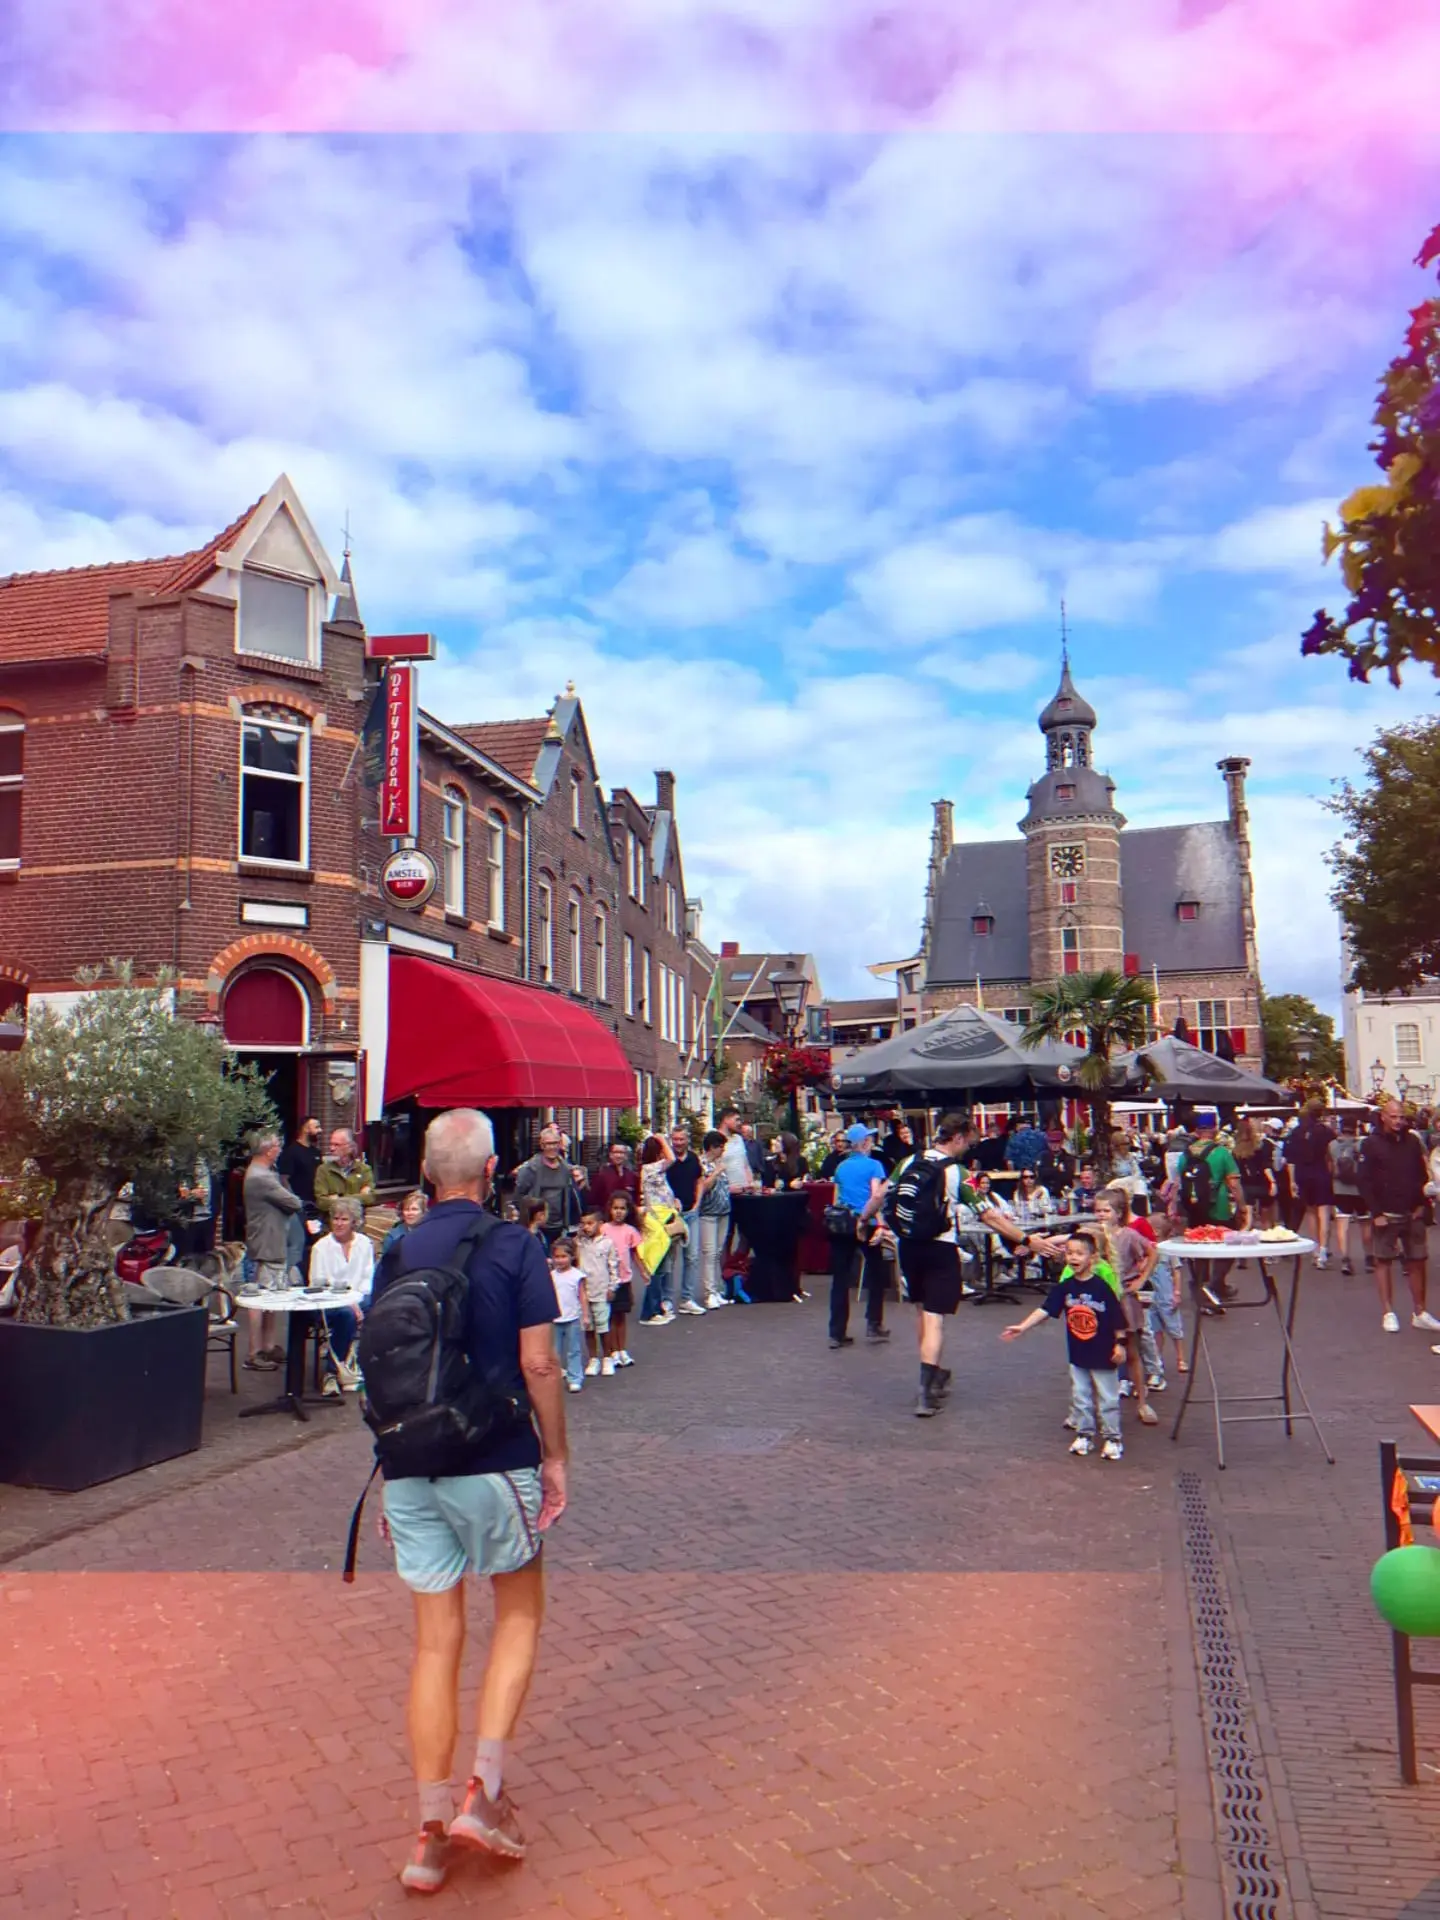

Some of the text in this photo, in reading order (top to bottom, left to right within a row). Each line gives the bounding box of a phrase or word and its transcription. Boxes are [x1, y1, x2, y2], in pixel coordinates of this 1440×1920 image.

[390, 672, 402, 697] De
[387, 868, 424, 879] AMSTEL
[923, 1026, 991, 1049] AMSTEL
